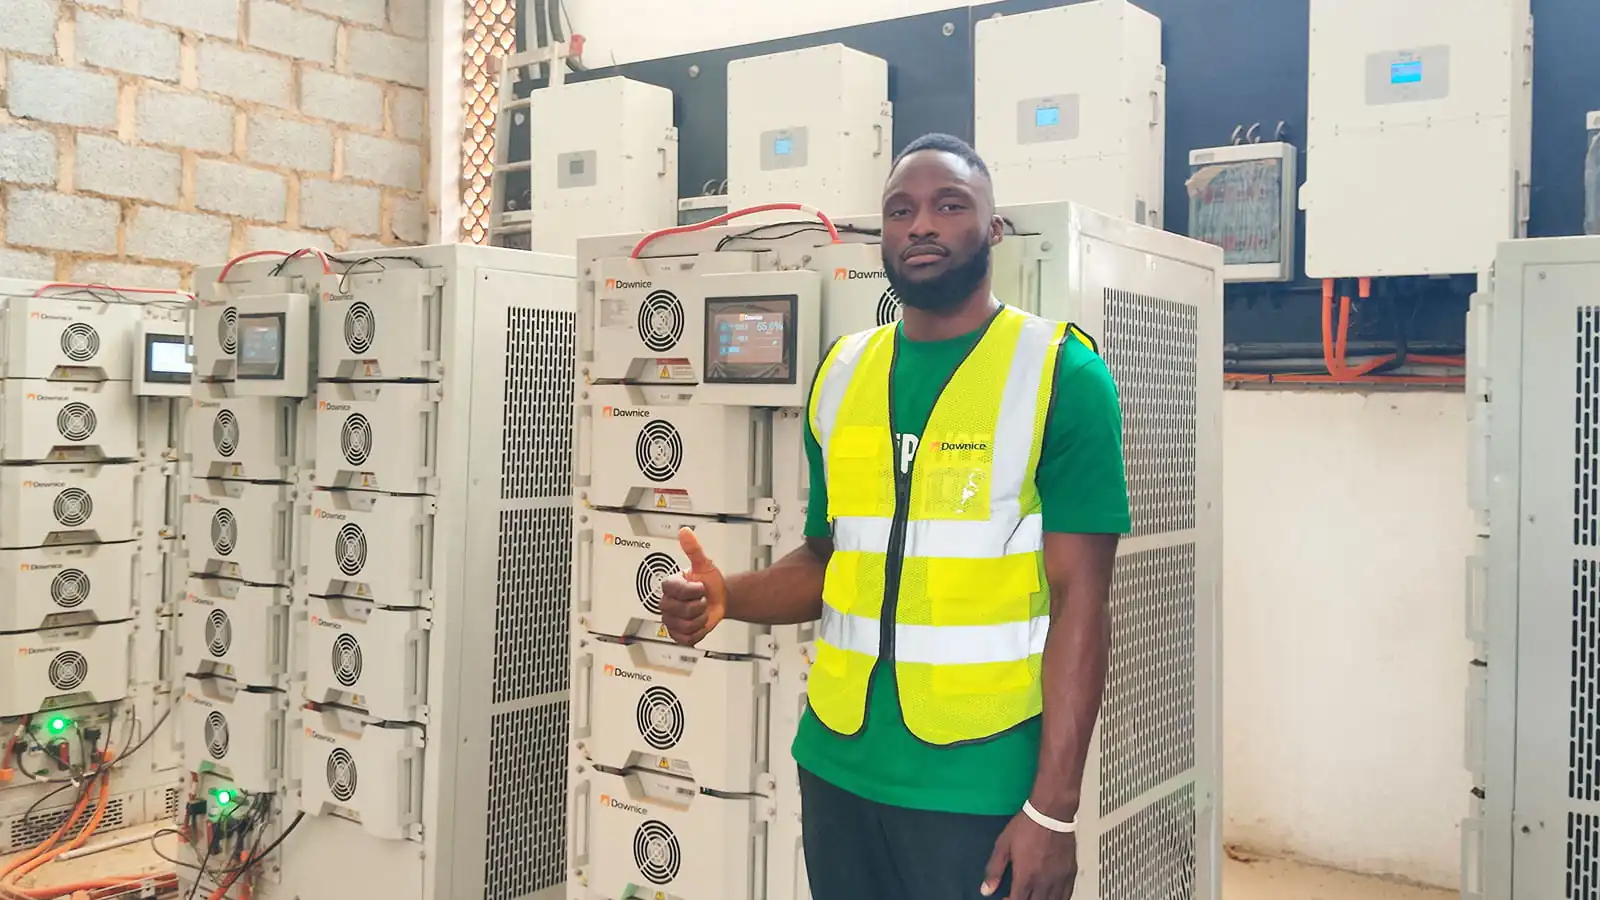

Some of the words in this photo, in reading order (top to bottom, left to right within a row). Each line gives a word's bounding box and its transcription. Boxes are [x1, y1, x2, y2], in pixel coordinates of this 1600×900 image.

[849, 270, 888, 279] Dawnic
[616, 280, 652, 289] Dawnice
[613, 408, 650, 418] Dawnice
[941, 442, 986, 451] Dawnice
[615, 536, 651, 549] Dawnice
[615, 668, 652, 682] Dawnice
[611, 798, 648, 815] Dawnice
